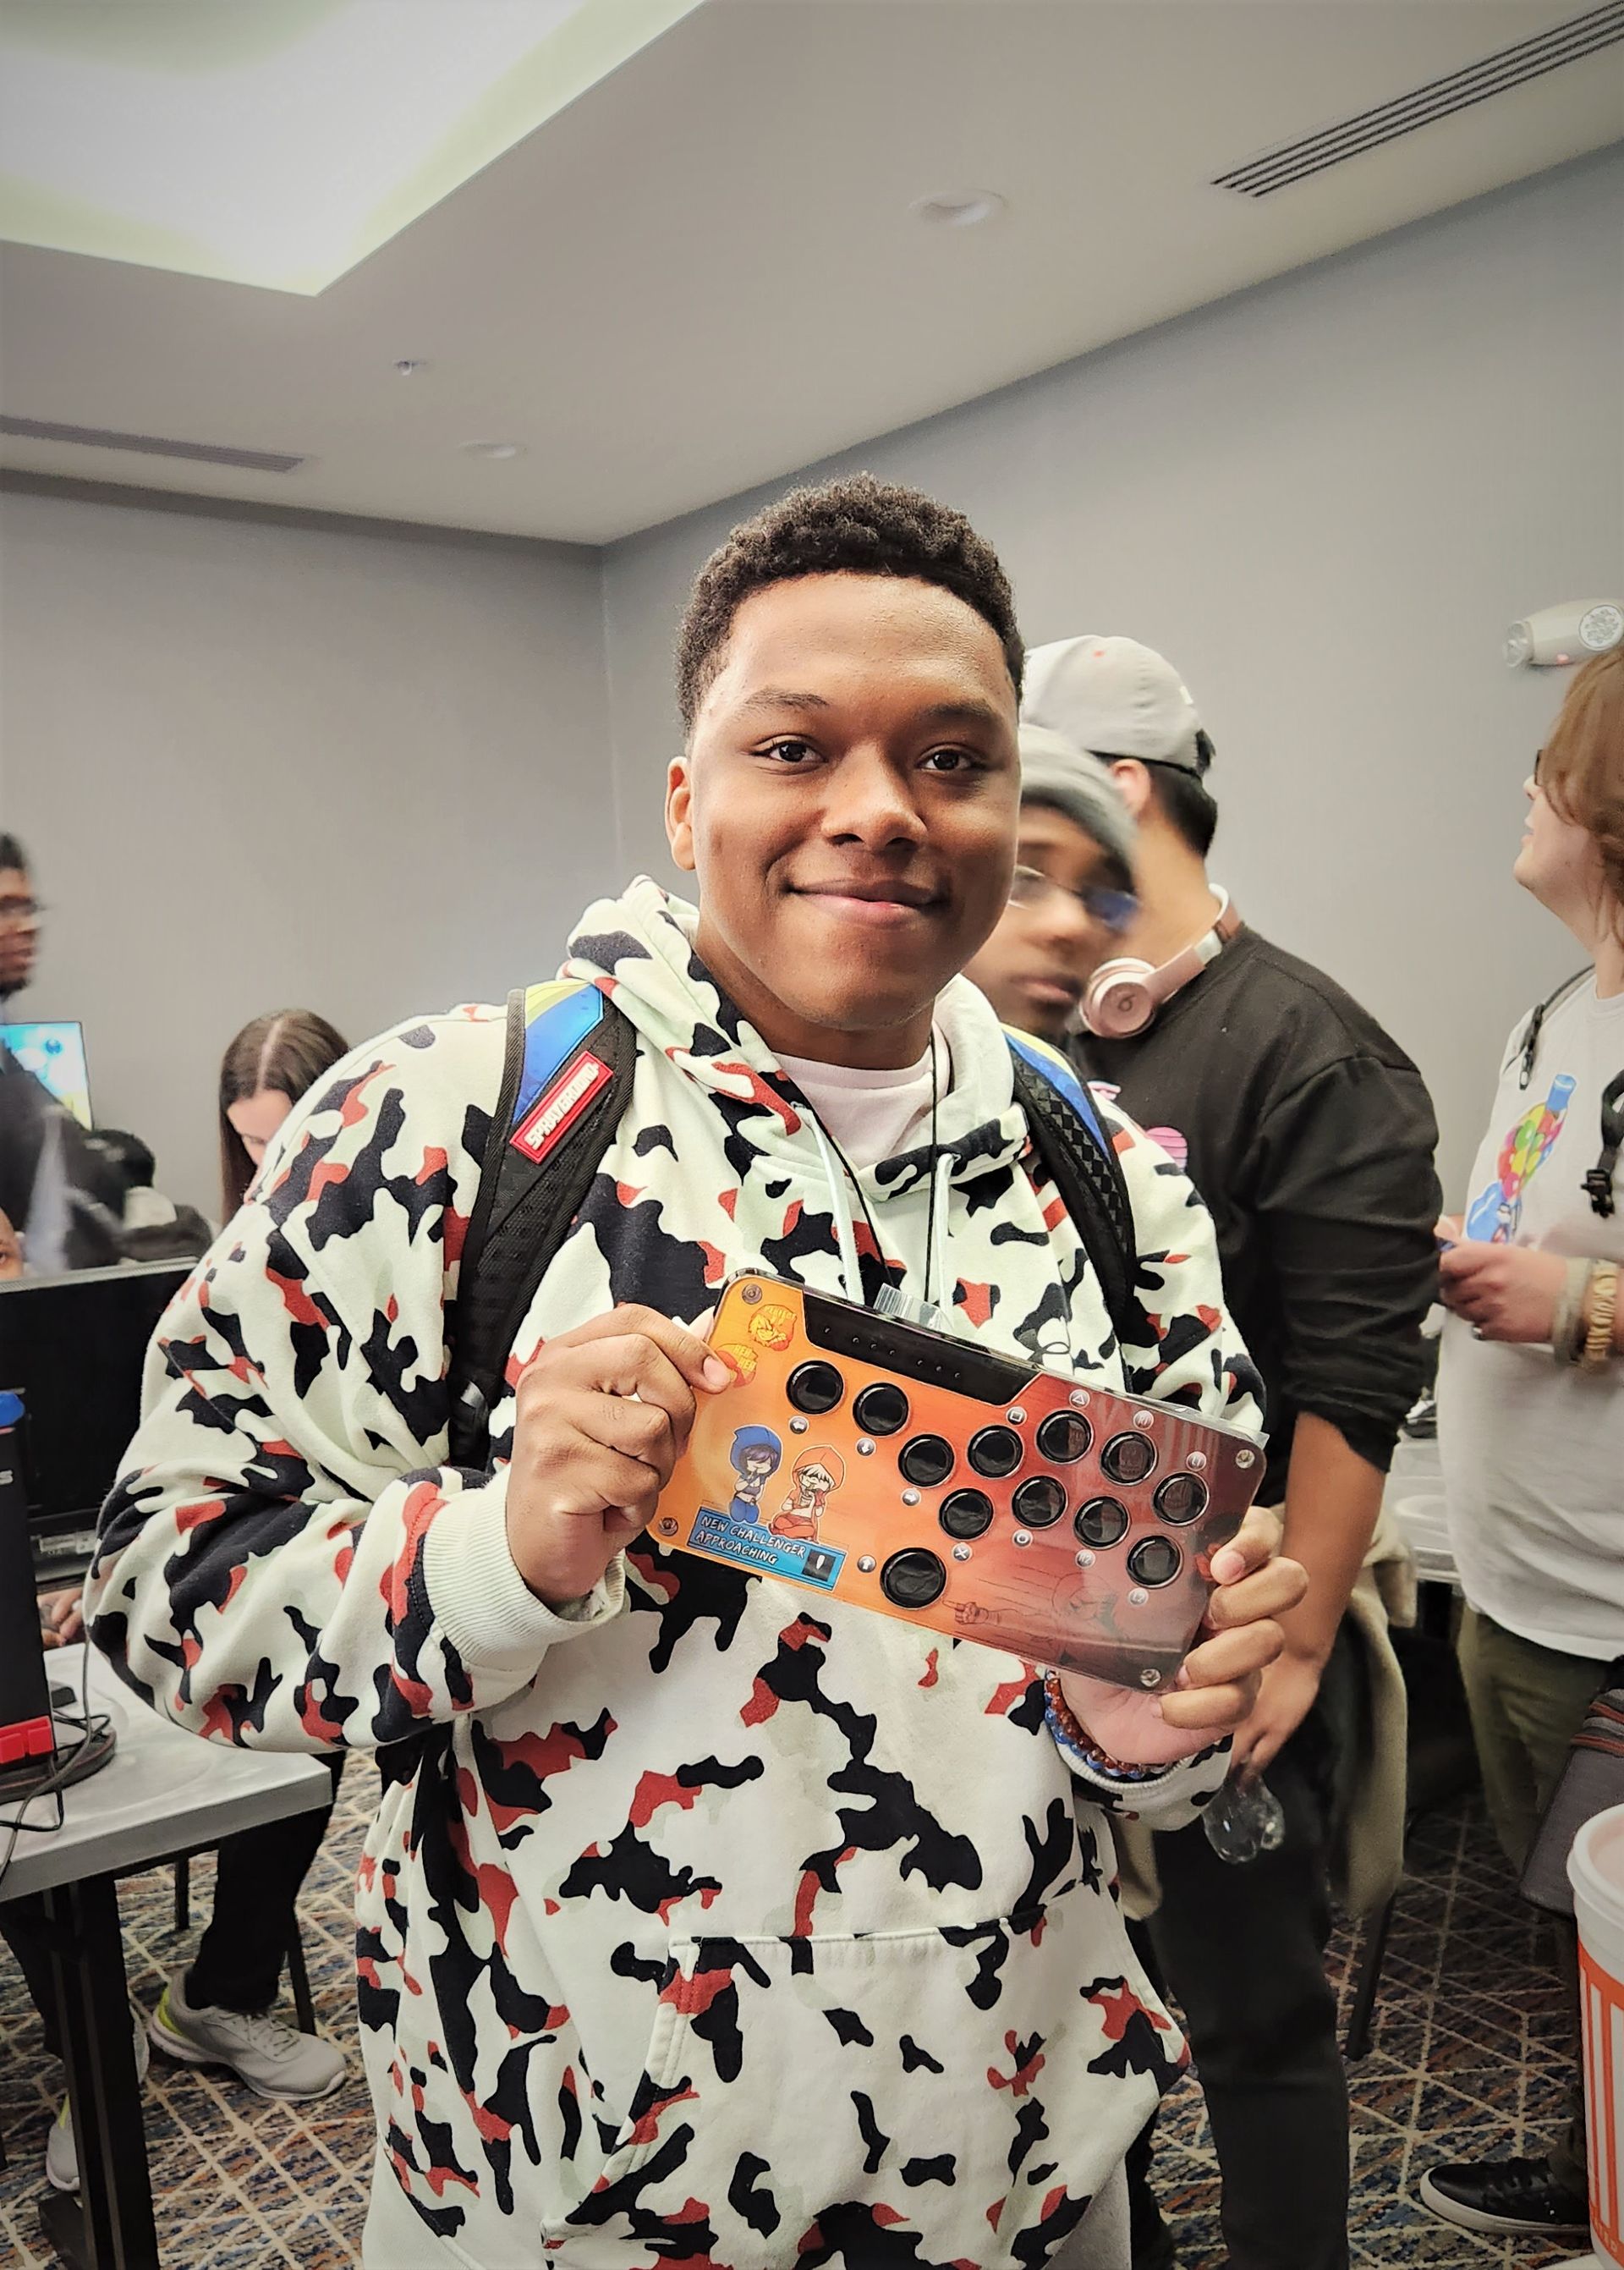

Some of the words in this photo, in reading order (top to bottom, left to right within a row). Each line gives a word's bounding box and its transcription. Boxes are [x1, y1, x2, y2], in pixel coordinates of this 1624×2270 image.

[523, 1061, 601, 1151] SPRAYGROUND
[695, 1530, 778, 1565] APPROACHING
[700, 1515, 729, 1532] NEW
[730, 1525, 806, 1558] CHALLENGER
